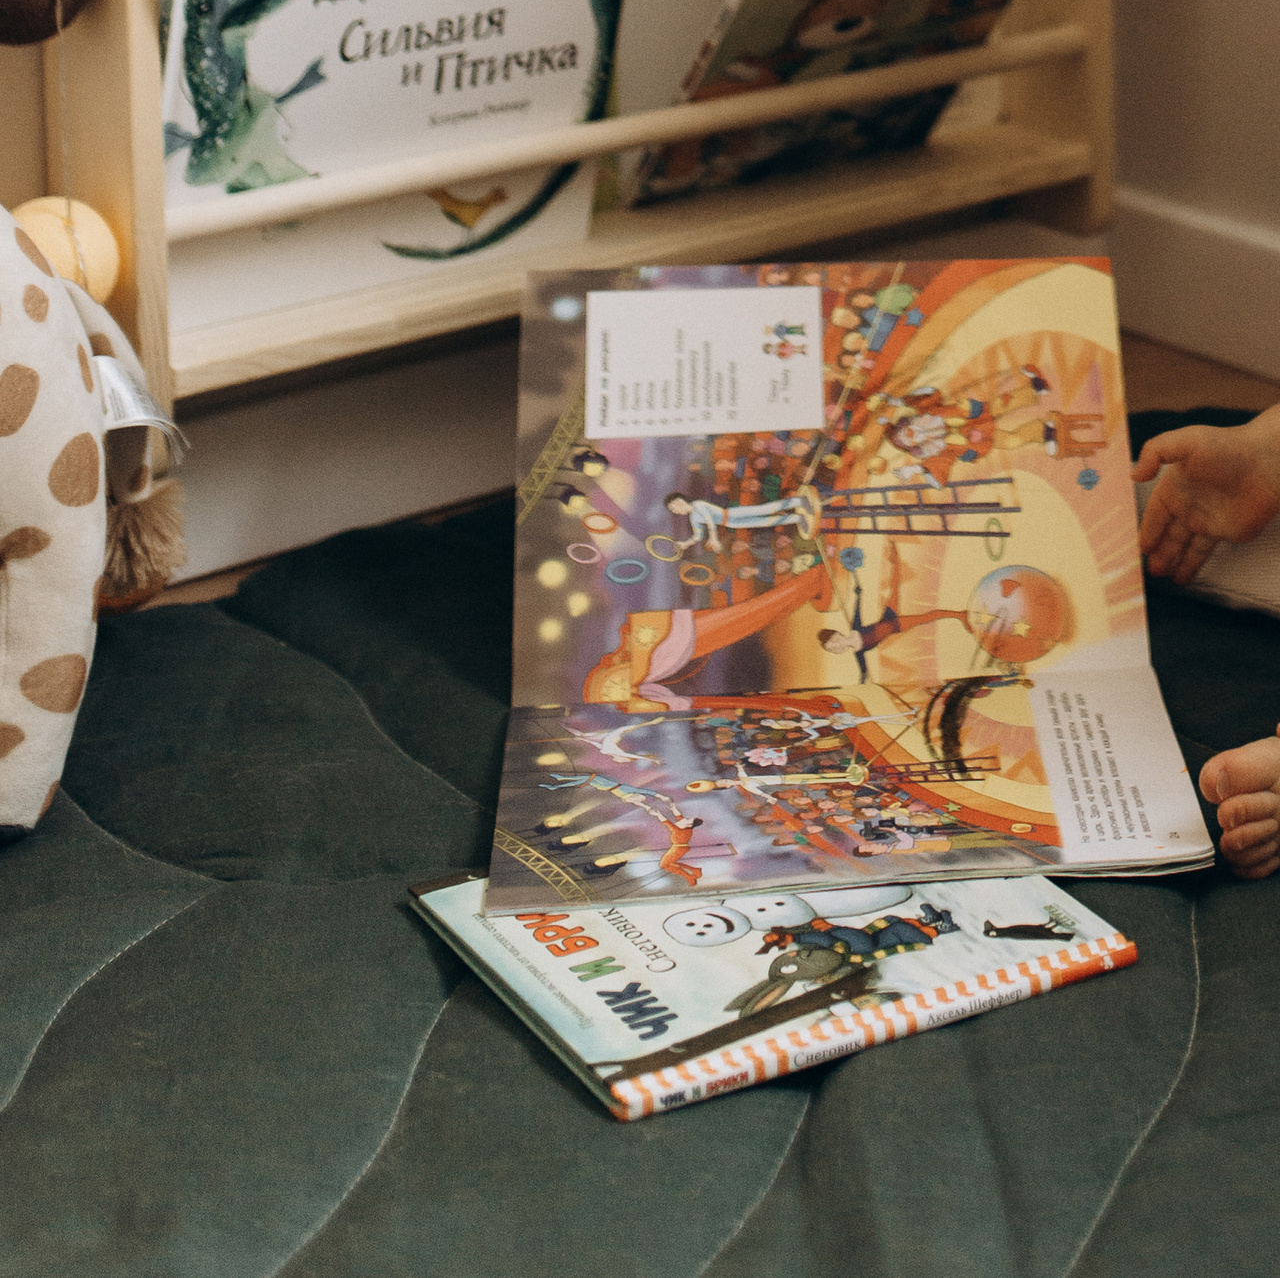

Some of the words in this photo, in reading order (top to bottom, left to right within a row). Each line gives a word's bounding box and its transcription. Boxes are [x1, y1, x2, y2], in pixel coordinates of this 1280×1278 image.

[338, 6, 507, 64] Сильвия
[401, 61, 423, 87] и
[434, 41, 579, 95] Птичка
[514, 913, 600, 957] БРИ
[598, 906, 677, 973] Снеговик
[568, 955, 627, 982] И
[596, 982, 679, 1041] ЧИК
[793, 1039, 863, 1068] Снеговик
[926, 1008, 968, 1027] Аксель
[967, 988, 1023, 1018] Шеффлер
